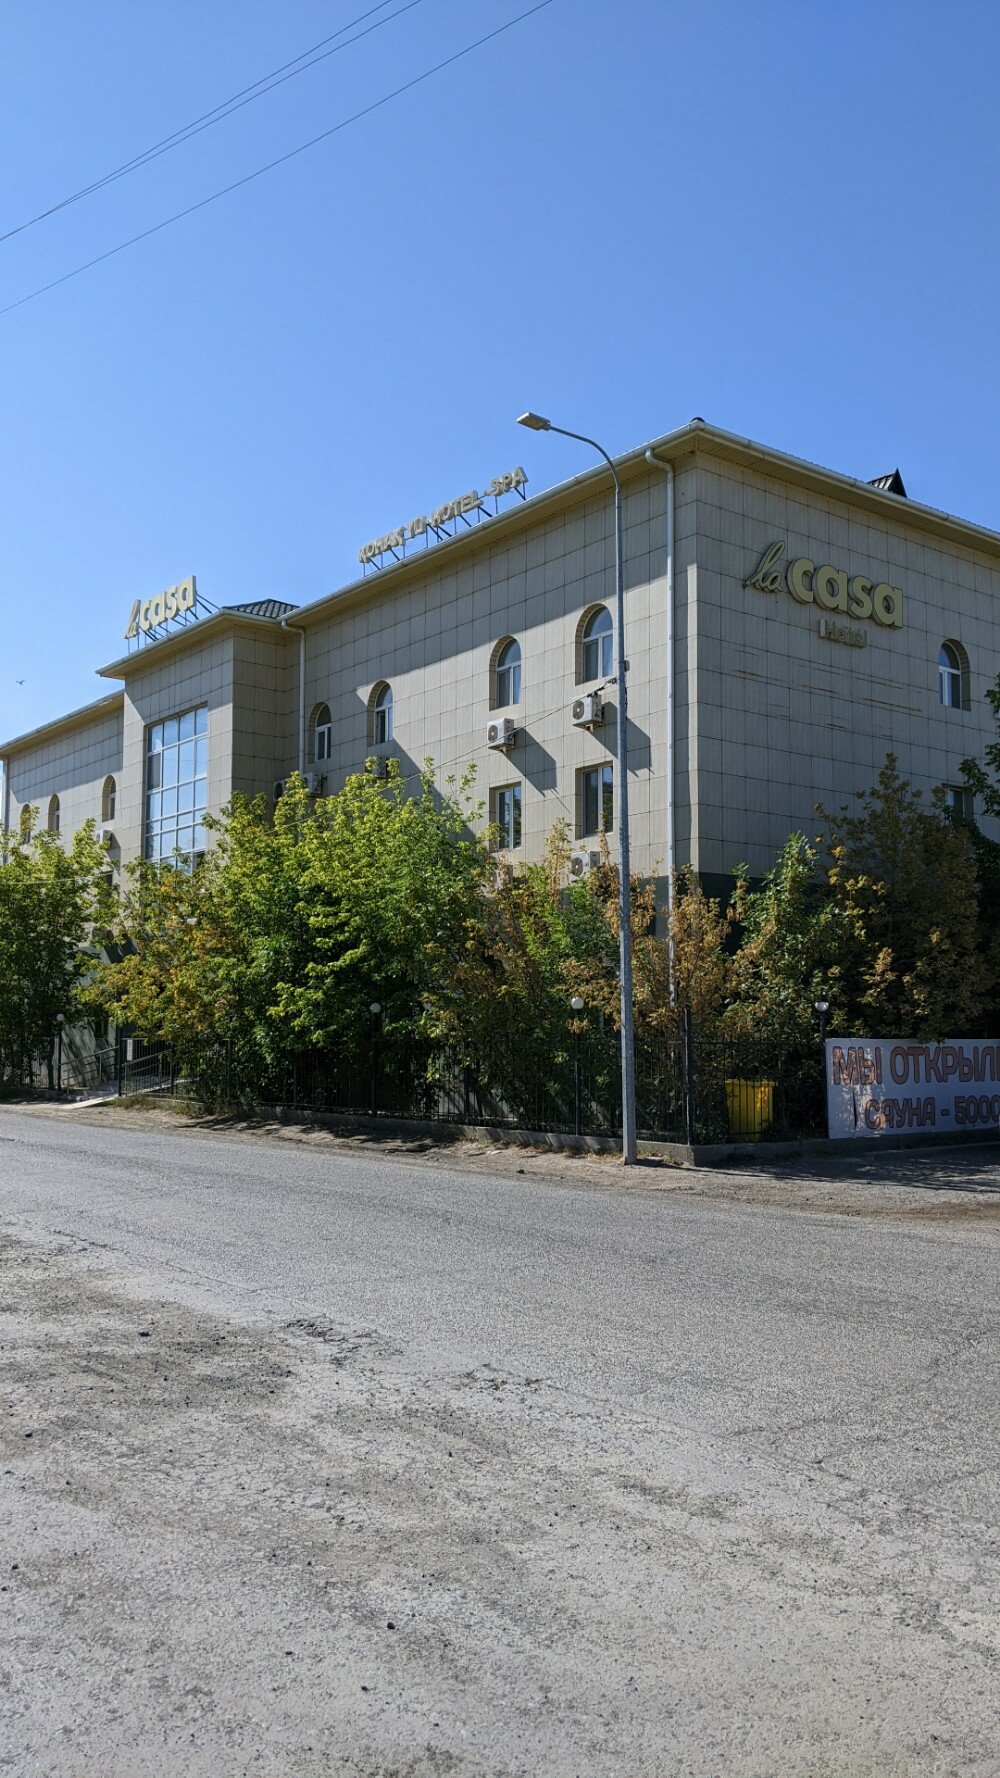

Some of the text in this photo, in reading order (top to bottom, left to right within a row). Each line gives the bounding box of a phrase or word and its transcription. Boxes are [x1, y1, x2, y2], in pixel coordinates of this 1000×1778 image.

[140, 575, 196, 632] casa
[742, 540, 904, 629] la casa
[819, 618, 868, 649] Hotel
[832, 1046, 1000, 1085] МЫ ОТКРЫЛ
[865, 1096, 936, 1129] САУНА
